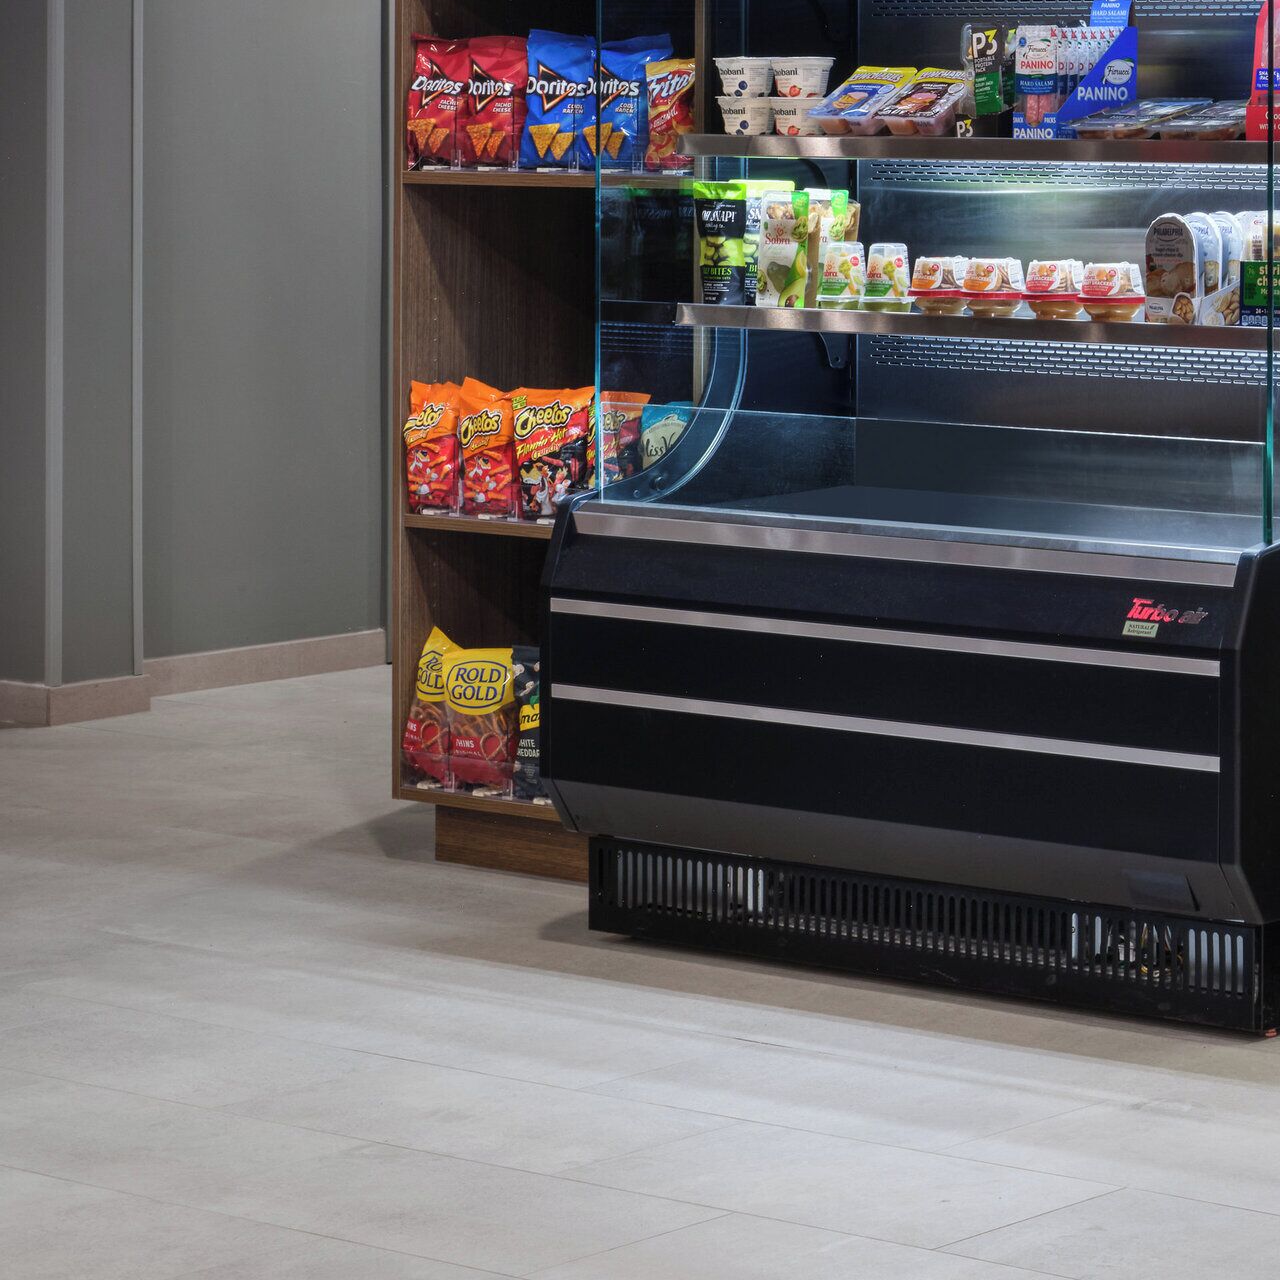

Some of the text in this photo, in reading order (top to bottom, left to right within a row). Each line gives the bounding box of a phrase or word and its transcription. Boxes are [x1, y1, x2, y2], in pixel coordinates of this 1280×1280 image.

[972, 29, 998, 58] P3
[1020, 61, 1053, 69] PANINO
[412, 76, 463, 94] Doritos
[526, 76, 586, 96] Doritos
[1077, 87, 1128, 100] PANINO
[956, 119, 973, 138] P3
[1013, 128, 1053, 139] PANINO
[765, 234, 790, 245] Sabra
[461, 410, 500, 443] Cheetos
[514, 401, 572, 438] Cheetos
[1127, 598, 1208, 624] Turbo air
[455, 667, 501, 684] ROLD
[451, 685, 497, 701] GOLD
